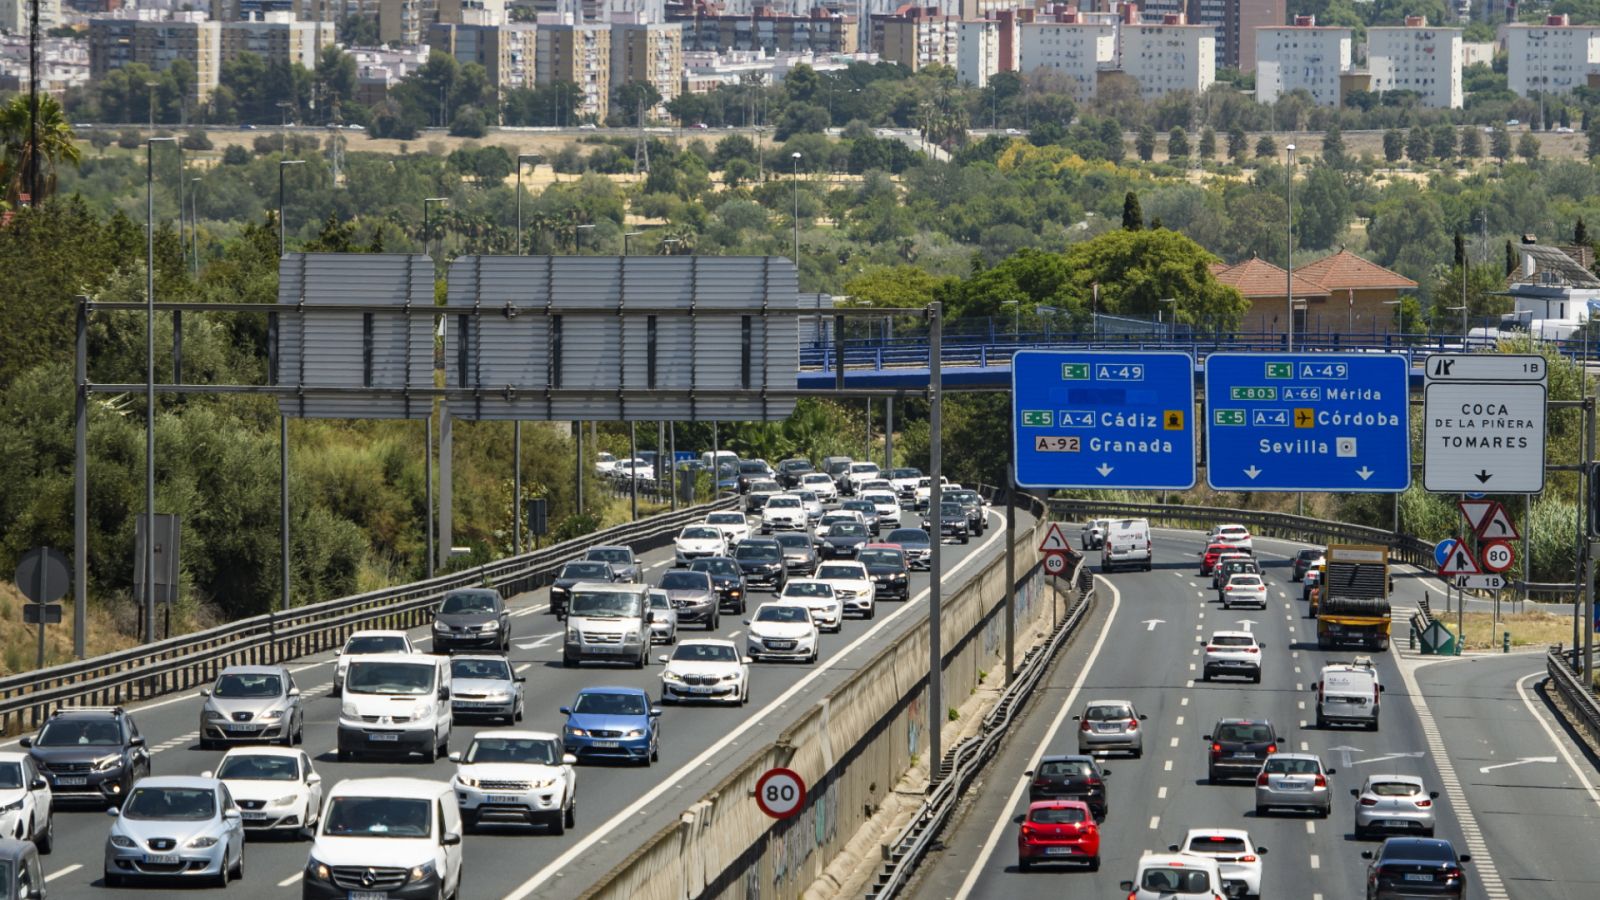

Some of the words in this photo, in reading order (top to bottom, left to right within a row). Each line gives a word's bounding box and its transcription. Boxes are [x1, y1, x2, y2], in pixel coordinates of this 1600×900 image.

[1063, 366, 1089, 378] E-1
[1099, 367, 1142, 378] A-49
[1267, 365, 1292, 377] E-1
[1302, 365, 1346, 377] A-49
[1523, 363, 1539, 373] 1B
[1232, 389, 1276, 398] E-803
[1285, 389, 1318, 399] A-66
[1326, 387, 1382, 400] Mérida
[1461, 403, 1508, 416] COCA
[1023, 413, 1051, 424] E-5
[1062, 413, 1093, 425] A-4
[1101, 411, 1157, 427] Cádiz
[1215, 412, 1244, 423] E-5
[1255, 412, 1287, 423] A-4
[1318, 410, 1399, 426] Córdoba
[1435, 419, 1455, 428] DE
[1459, 419, 1475, 428] LA
[1482, 418, 1534, 429] PIÑERA
[1037, 438, 1079, 450] A-92
[1089, 437, 1172, 453] Granada
[1259, 438, 1328, 454] Sevilla
[1442, 436, 1528, 448] TOMARES
[1489, 550, 1508, 562] 80
[1048, 559, 1062, 568] 80
[1485, 578, 1500, 587] 1B
[766, 784, 795, 802] 80
